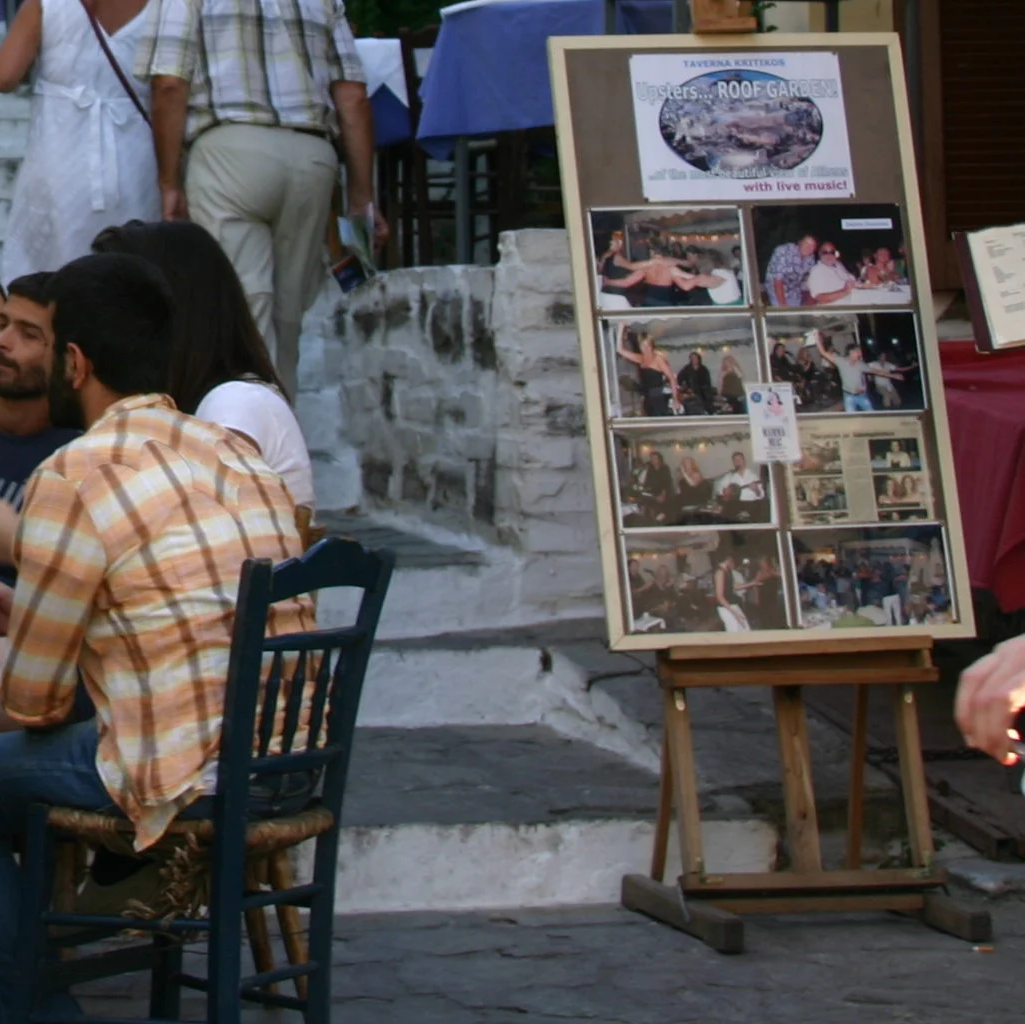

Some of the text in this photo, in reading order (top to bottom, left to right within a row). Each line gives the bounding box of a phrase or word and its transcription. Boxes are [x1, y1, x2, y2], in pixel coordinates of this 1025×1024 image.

[717, 80, 762, 98] ROOF
[743, 179, 848, 192] with live music!
